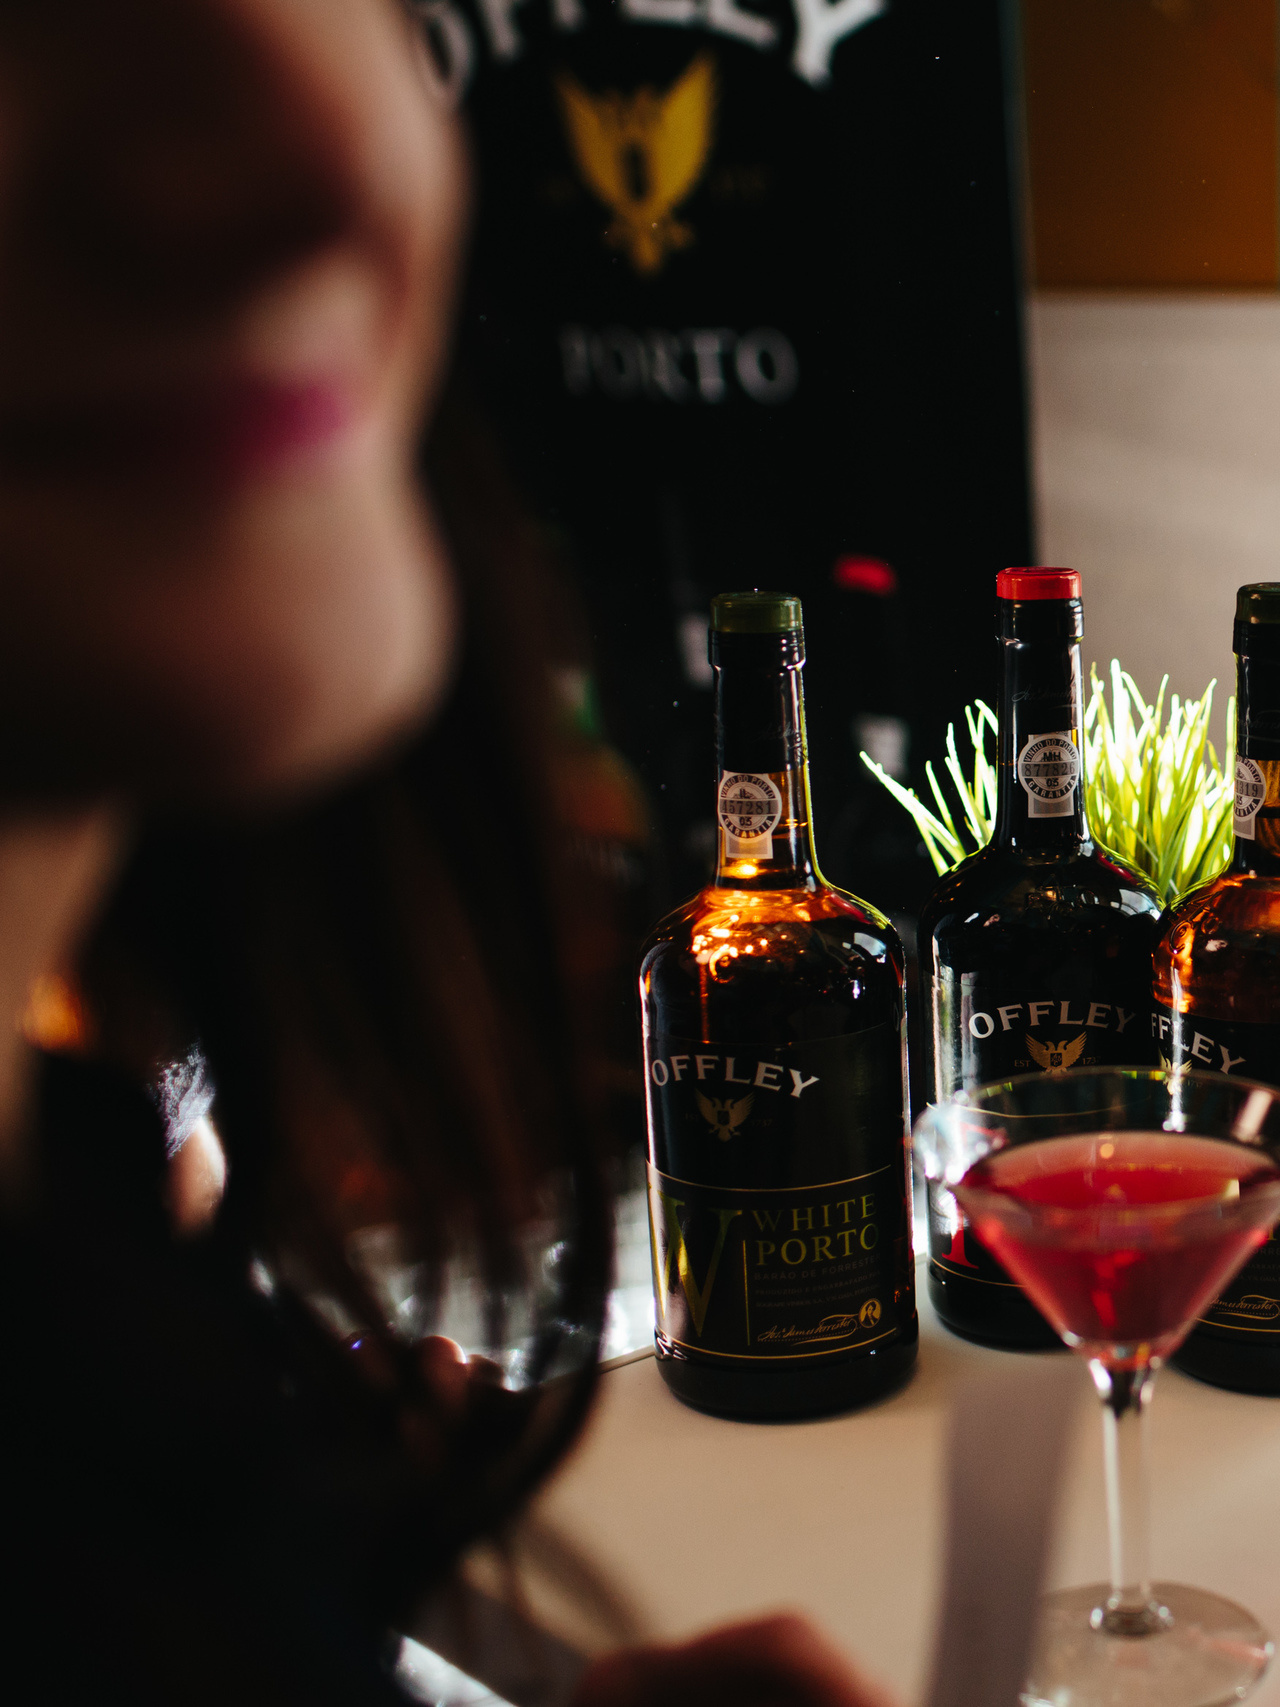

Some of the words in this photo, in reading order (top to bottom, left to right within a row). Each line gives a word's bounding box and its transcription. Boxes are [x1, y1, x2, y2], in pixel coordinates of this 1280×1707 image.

[1025, 762, 1075, 777] 877826
[751, 777, 776, 799] PORTO
[1028, 779, 1075, 798] GARANTIA
[724, 818, 773, 838] GARANTIA
[968, 1000, 1137, 1039] OFFLEY
[1151, 1011, 1247, 1076] FFLEY
[1014, 1059, 1030, 1068] EST
[651, 1054, 820, 1099] OFFLEY
[751, 1192, 878, 1233] WHITE
[755, 1222, 880, 1266] PORTO
[801, 1269, 817, 1279] DE
